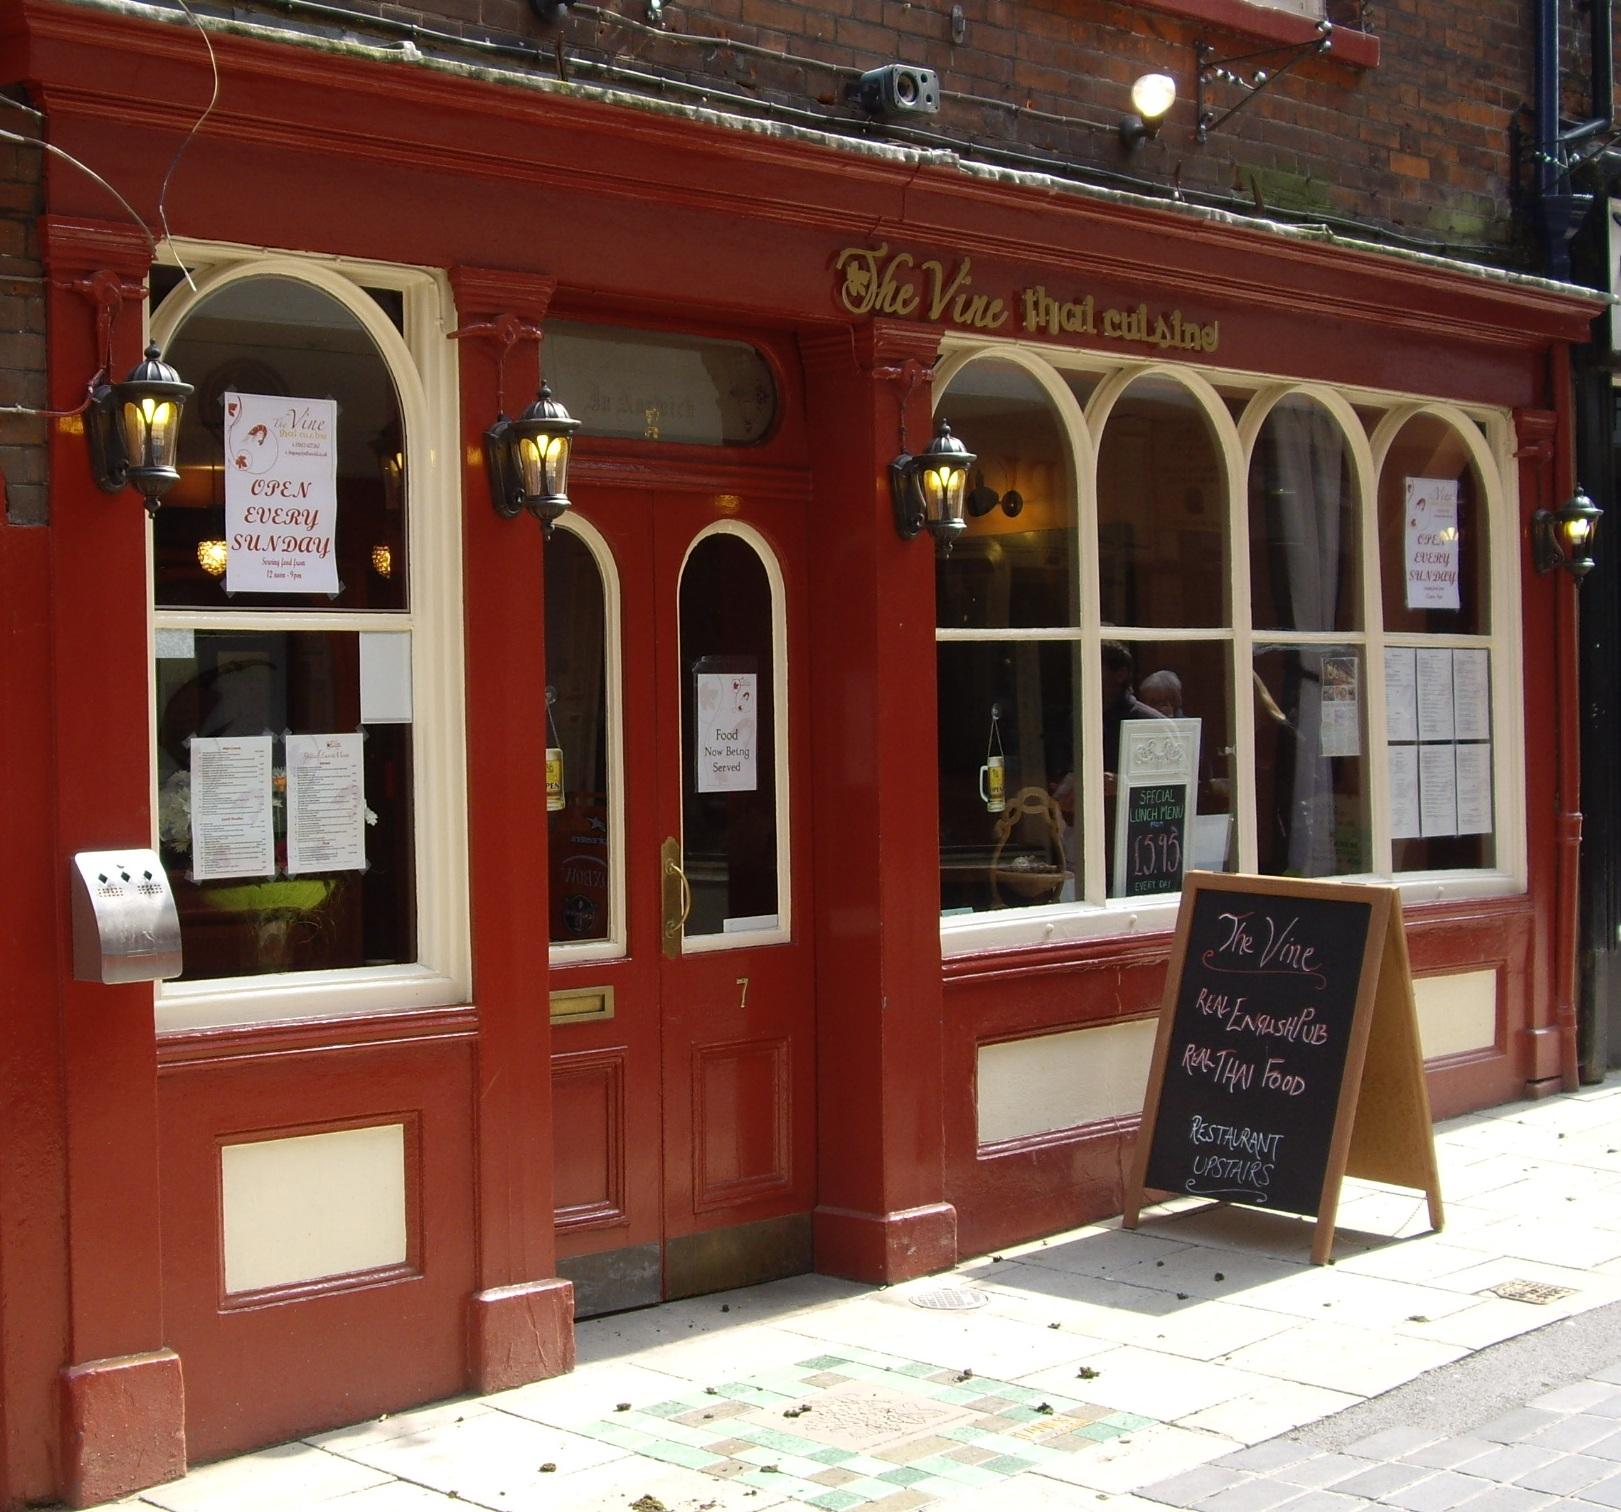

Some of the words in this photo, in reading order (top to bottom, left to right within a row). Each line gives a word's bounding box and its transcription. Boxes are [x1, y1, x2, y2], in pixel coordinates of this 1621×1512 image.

[837, 242, 919, 314] The
[922, 256, 1009, 328] Vine
[1022, 286, 1097, 336] thai
[1103, 303, 1220, 353] cuisine
[285, 407, 325, 431] Vine
[251, 479, 312, 499] OPEN
[243, 506, 319, 532] EVERY
[231, 533, 331, 560] SUNDAY
[1414, 551, 1451, 568] EVERY
[1409, 570, 1457, 586] SUNDAY
[716, 728, 738, 741] Food
[704, 746, 723, 758] Now
[726, 746, 750, 760] Being
[712, 762, 741, 774] Served
[1140, 789, 1175, 805] SPECIAL
[1130, 808, 1158, 823] LUNCH
[1160, 804, 1184, 821] MENU
[1135, 880, 1156, 892] EVERY
[1159, 879, 1171, 889] DAY
[1217, 912, 1255, 954] The
[1260, 915, 1322, 972] Vine
[736, 977, 749, 1009] 7
[1194, 987, 1230, 1018] REAL
[1181, 1043, 1214, 1075] REAL
[1213, 1049, 1254, 1094] THAI
[1260, 1058, 1305, 1097] FOOD
[1189, 1114, 1284, 1161] RESTAURANT
[1192, 1155, 1274, 1188] UPSTAIRS
